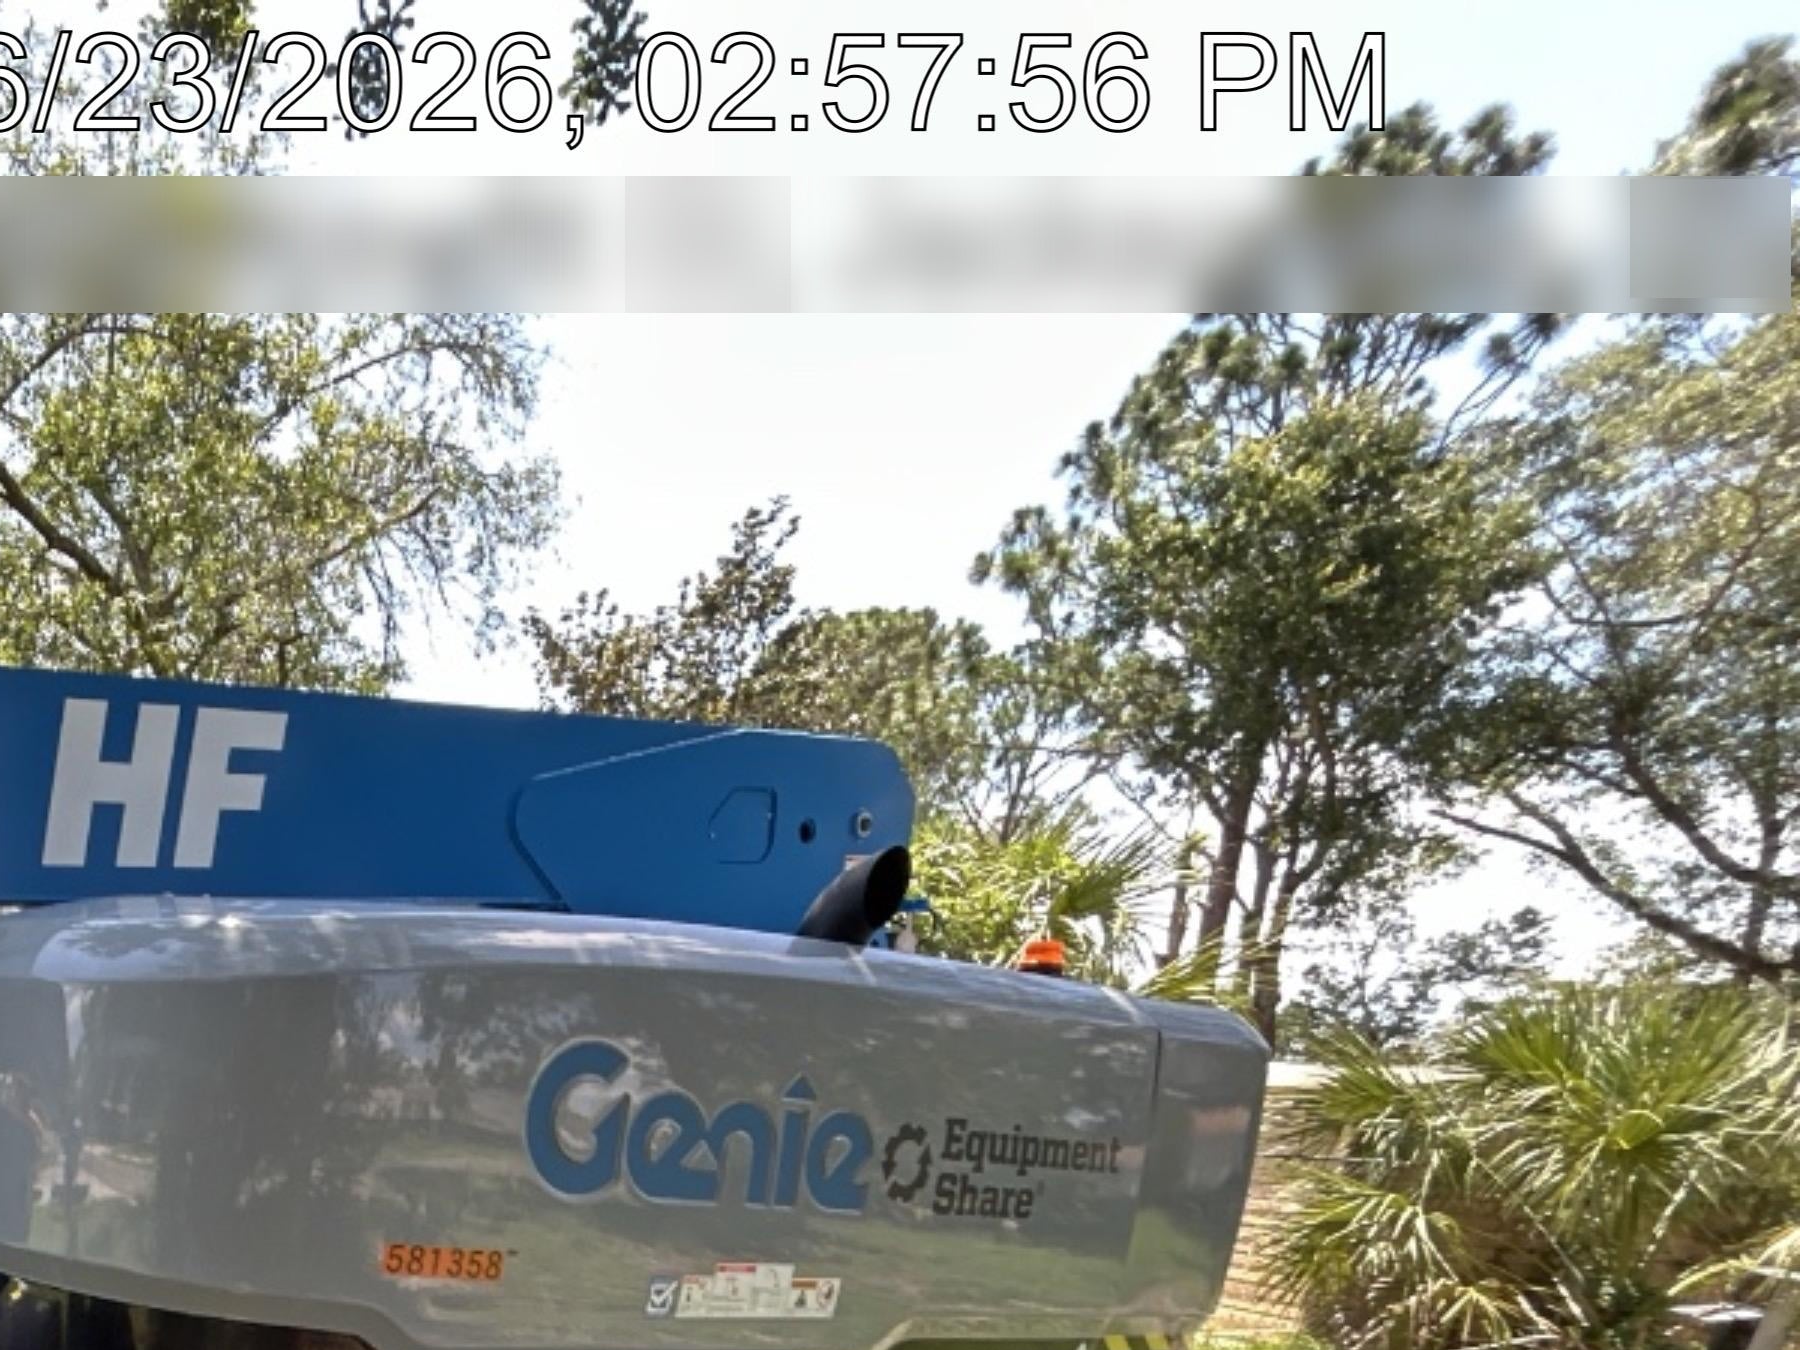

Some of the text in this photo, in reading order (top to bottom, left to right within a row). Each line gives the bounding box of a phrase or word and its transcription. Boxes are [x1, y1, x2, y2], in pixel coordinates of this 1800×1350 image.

[42, 697, 289, 868] HF
[526, 1037, 874, 1214] Genie
[940, 1117, 1122, 1176] Equipment
[932, 1172, 1036, 1219] Share
[386, 1244, 502, 1279] 581358
